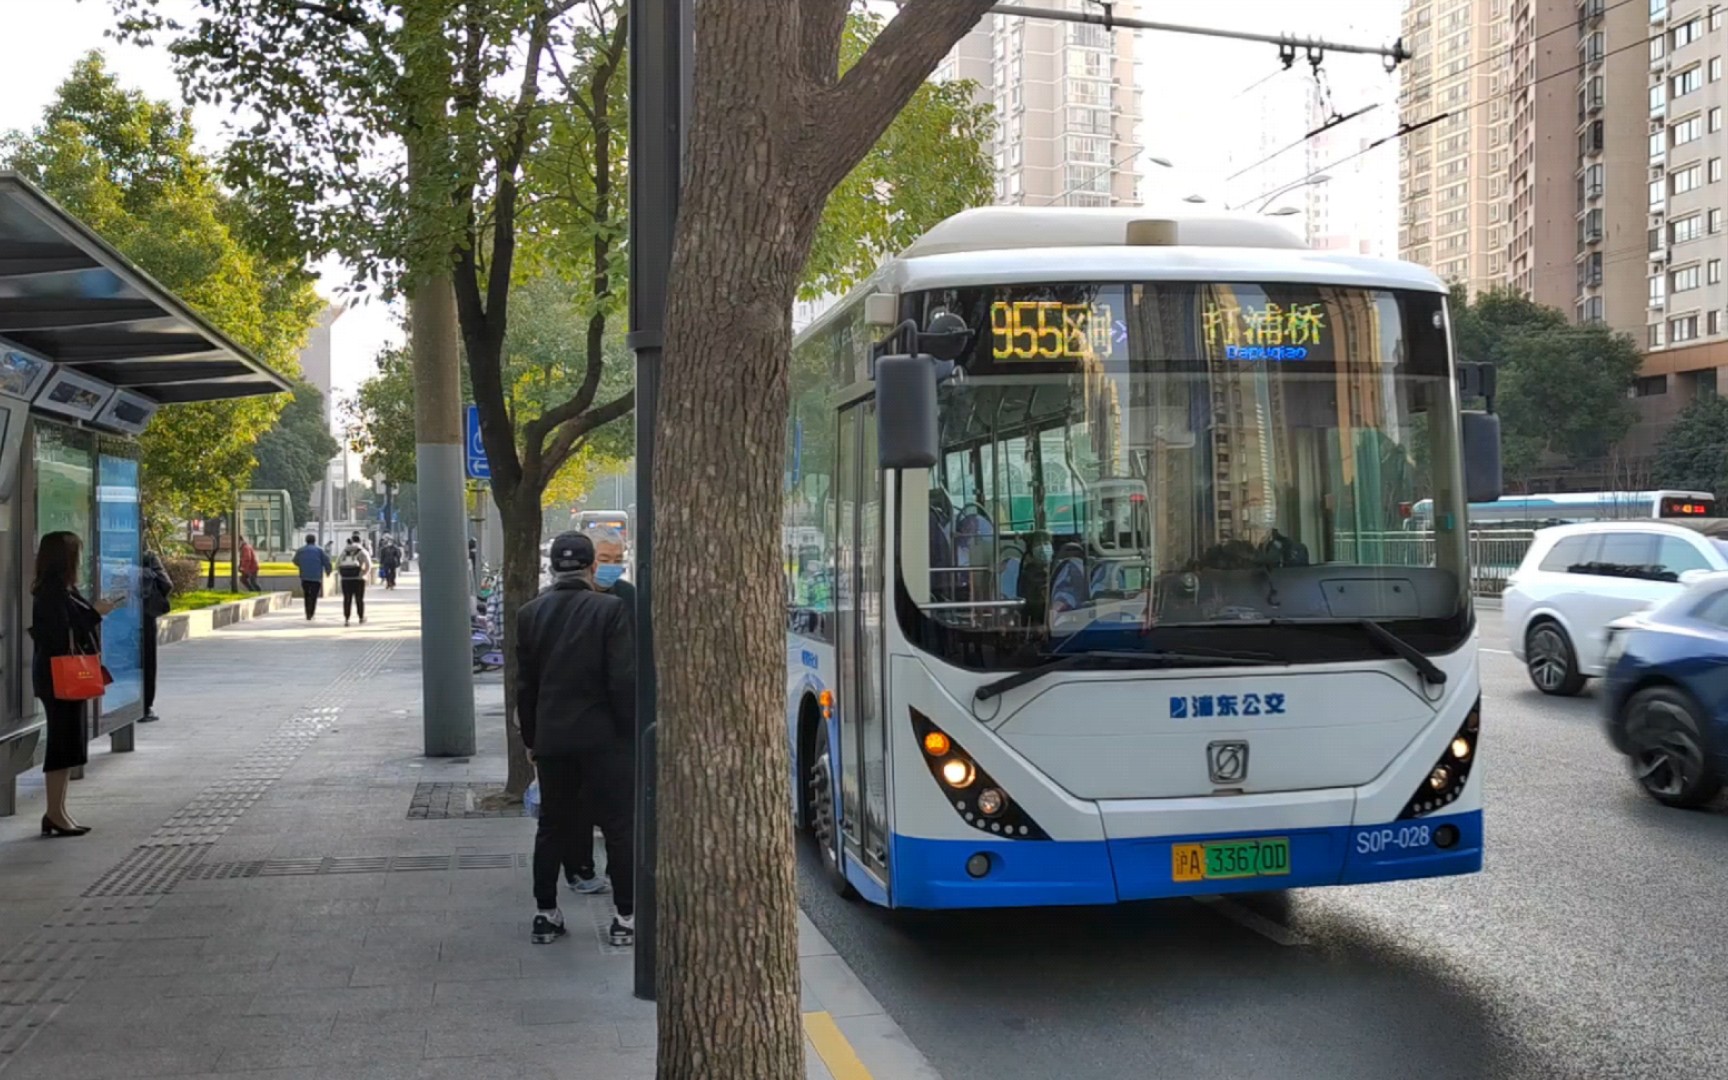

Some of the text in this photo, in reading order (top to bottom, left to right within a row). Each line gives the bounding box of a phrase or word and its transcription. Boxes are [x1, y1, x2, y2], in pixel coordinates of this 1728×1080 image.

[990, 302, 1112, 359] 955区间
[1202, 303, 1326, 345] 打浦桥
[1191, 693, 1286, 718] 浦东公交
